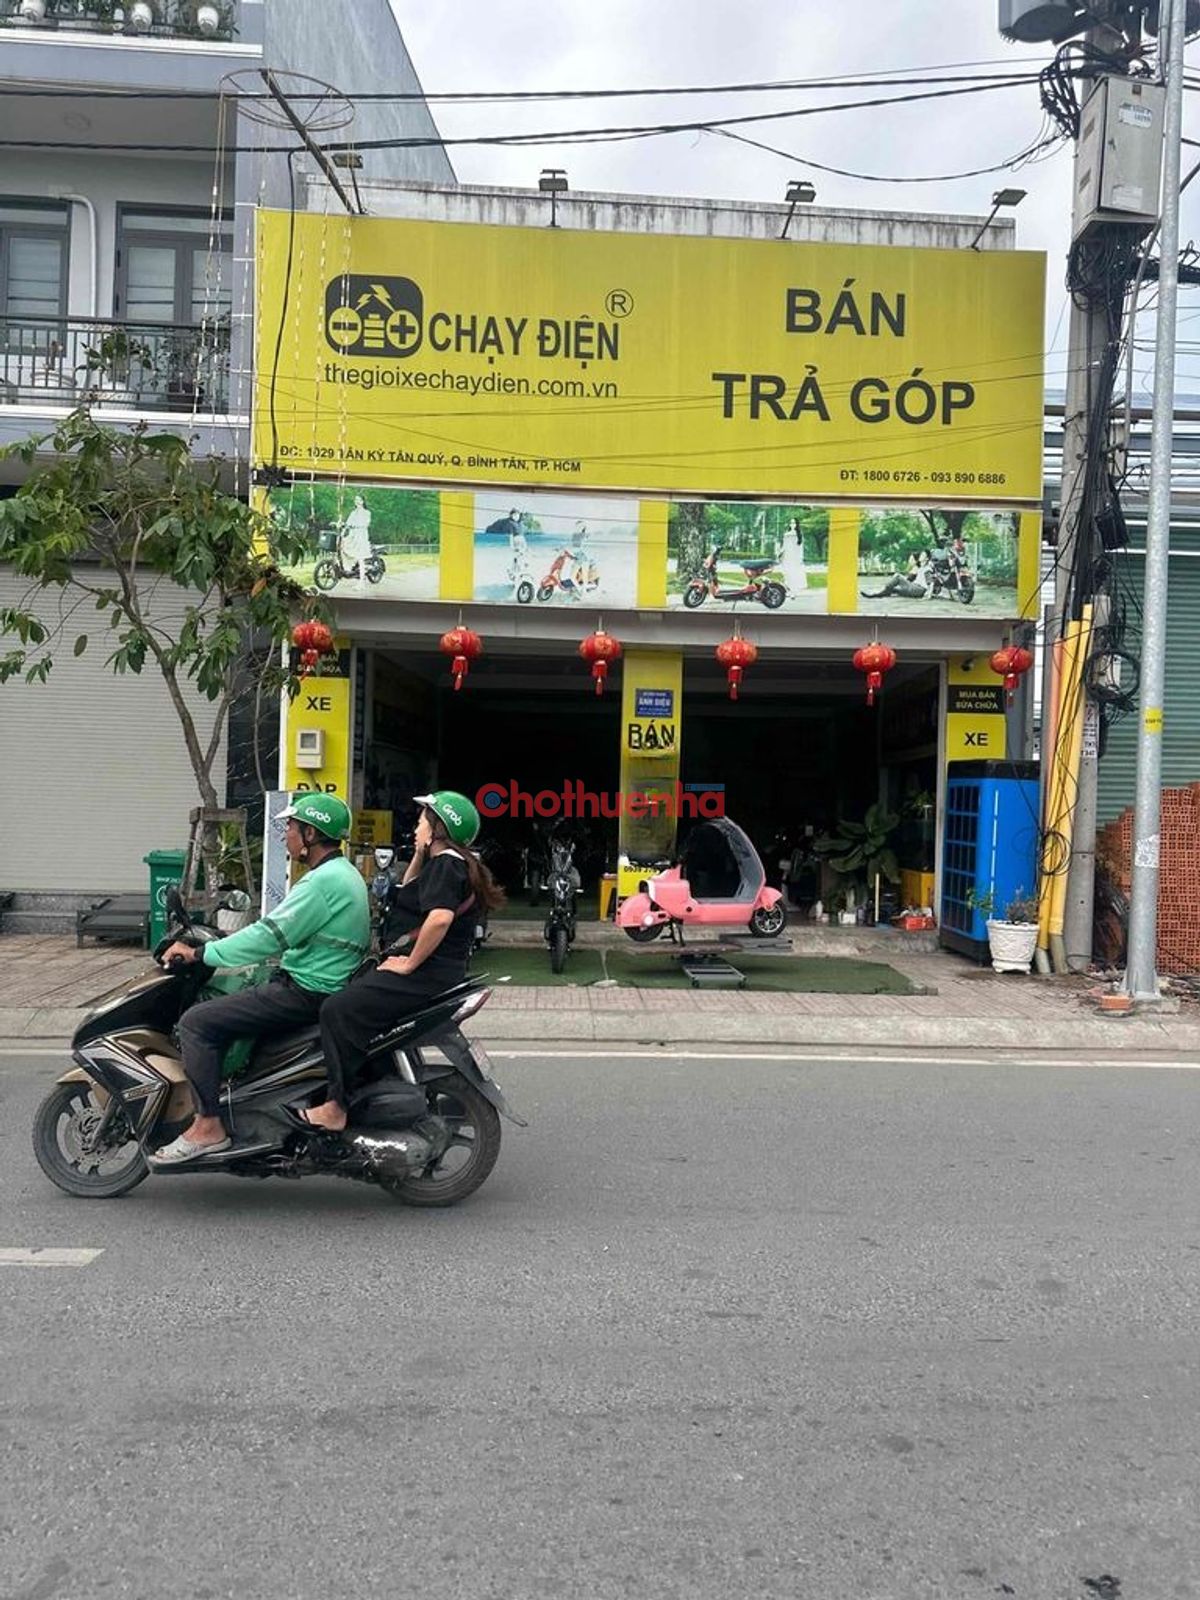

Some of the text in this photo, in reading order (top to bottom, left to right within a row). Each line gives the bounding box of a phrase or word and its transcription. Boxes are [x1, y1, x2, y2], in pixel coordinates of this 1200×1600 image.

[786, 279, 906, 338] BÁN
[429, 313, 619, 369] CHẠY ĐIỆN
[325, 362, 618, 398] thegioixechaydien.com.vn
[713, 364, 975, 425] TRẢ GÓP
[307, 448, 334, 459] 1029
[388, 450, 414, 463] TÂN
[451, 455, 464, 466] Q.
[467, 454, 497, 468] BÌNH
[501, 456, 529, 471] TÂN,
[533, 459, 550, 472] TP.
[553, 461, 581, 473] HCM
[840, 470, 859, 481] ĐT:
[863, 470, 890, 482] 1800
[893, 471, 921, 483] 6726
[931, 472, 952, 484] 093
[954, 472, 975, 484] 890
[978, 473, 1006, 485] 6886
[307, 696, 331, 711] XE
[965, 732, 989, 747] XE
[305, 806, 332, 823] Grab
[442, 804, 463, 826] Grab
